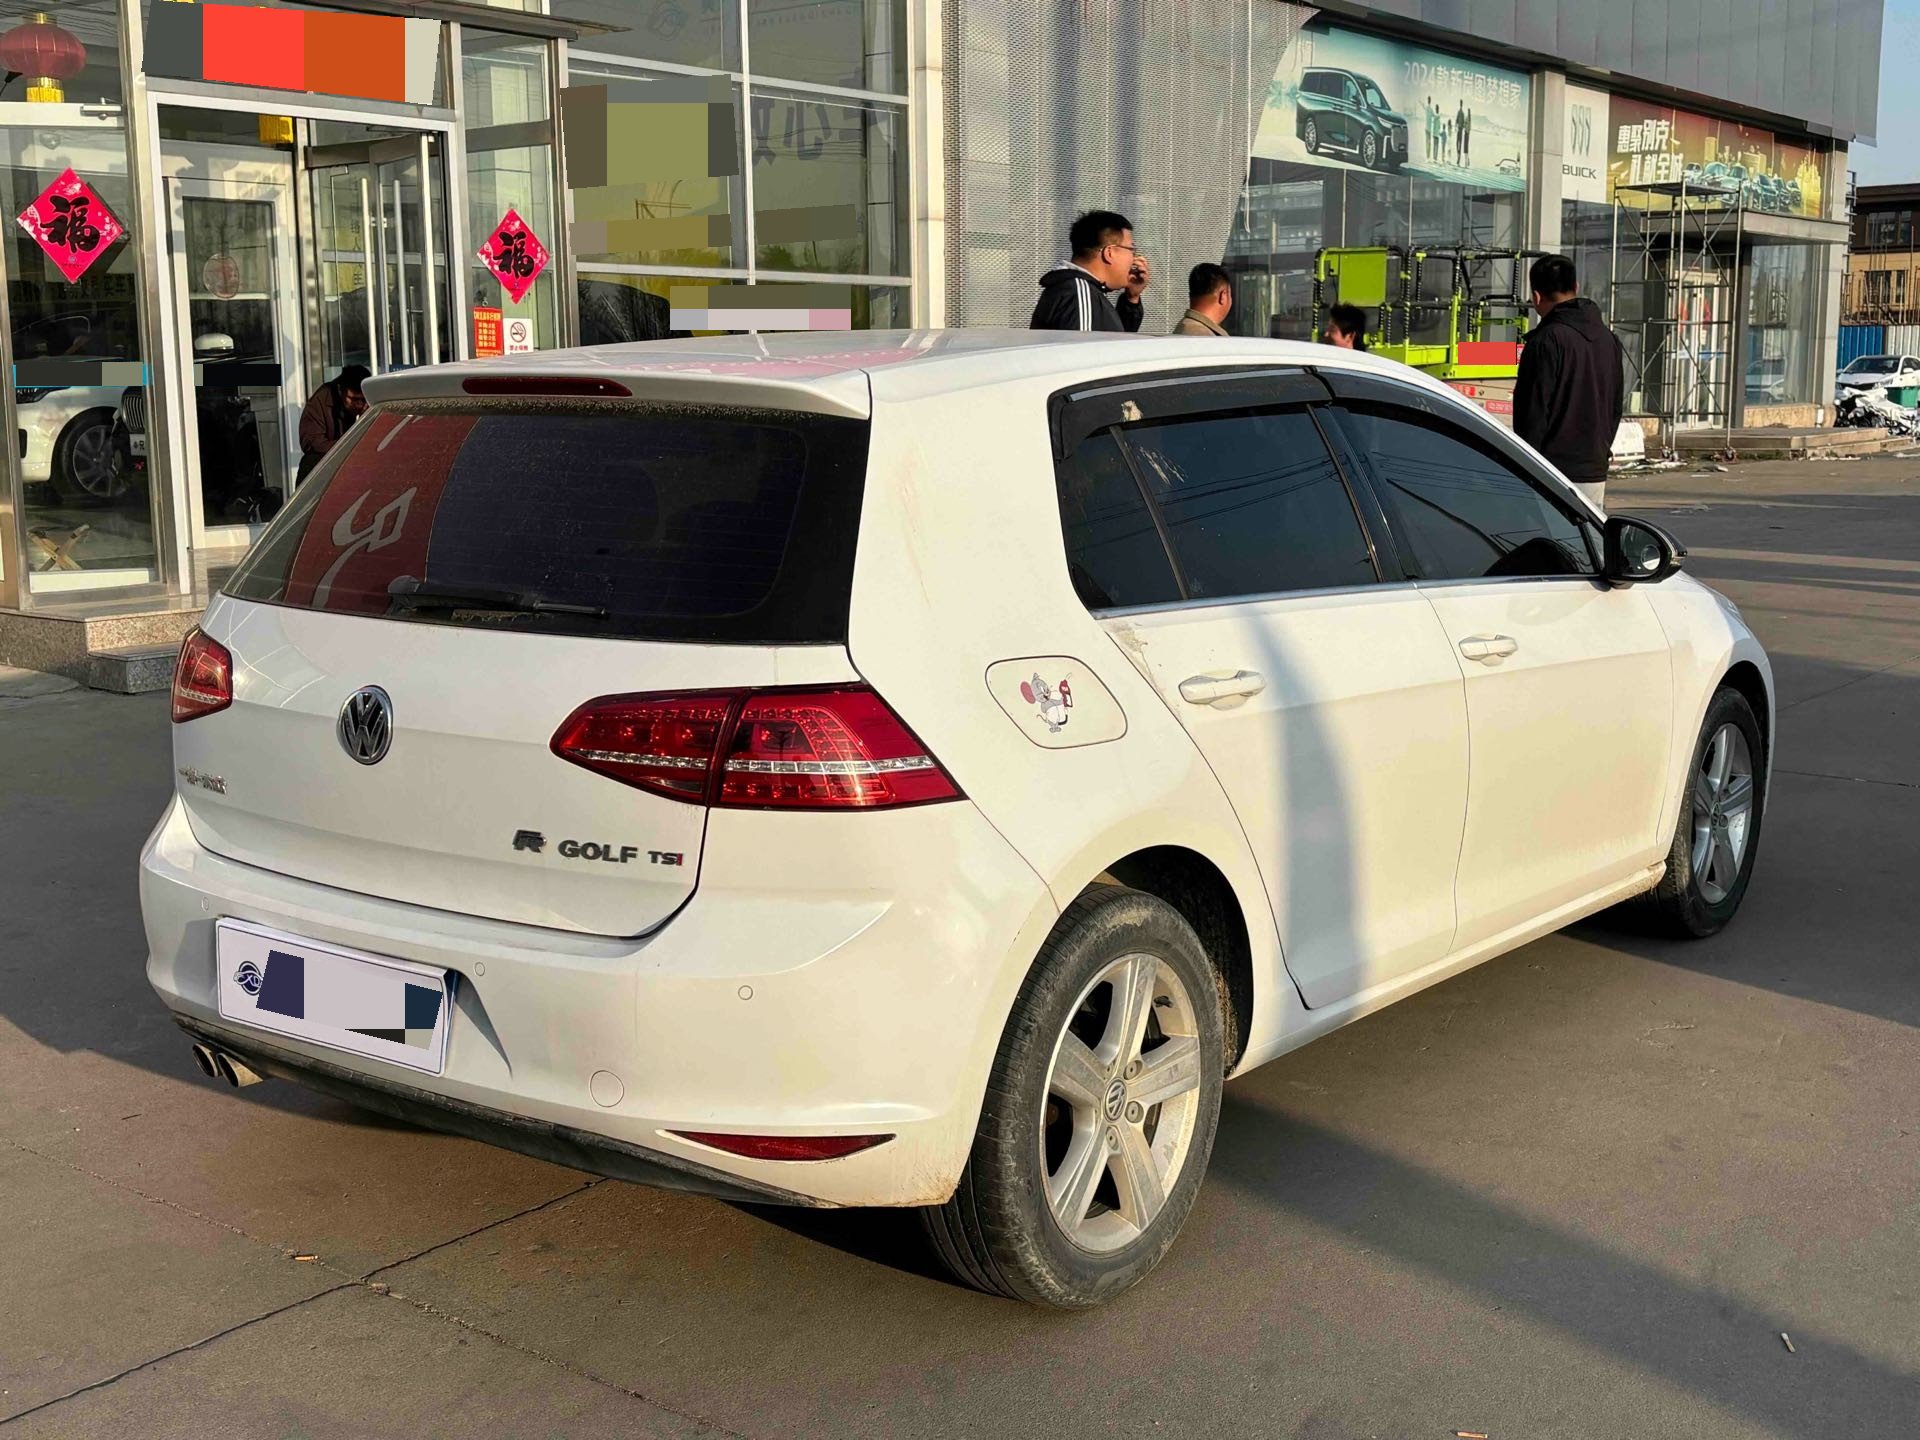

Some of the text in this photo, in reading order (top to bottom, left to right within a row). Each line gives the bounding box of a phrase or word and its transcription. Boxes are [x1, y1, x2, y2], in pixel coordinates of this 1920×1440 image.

[1616, 119, 1670, 154] 惠聚别克
[1562, 164, 1597, 180] BUICK
[39, 194, 101, 254] 福
[492, 230, 535, 280] 福
[557, 839, 639, 864] GOLF
[648, 850, 684, 867] TSI
